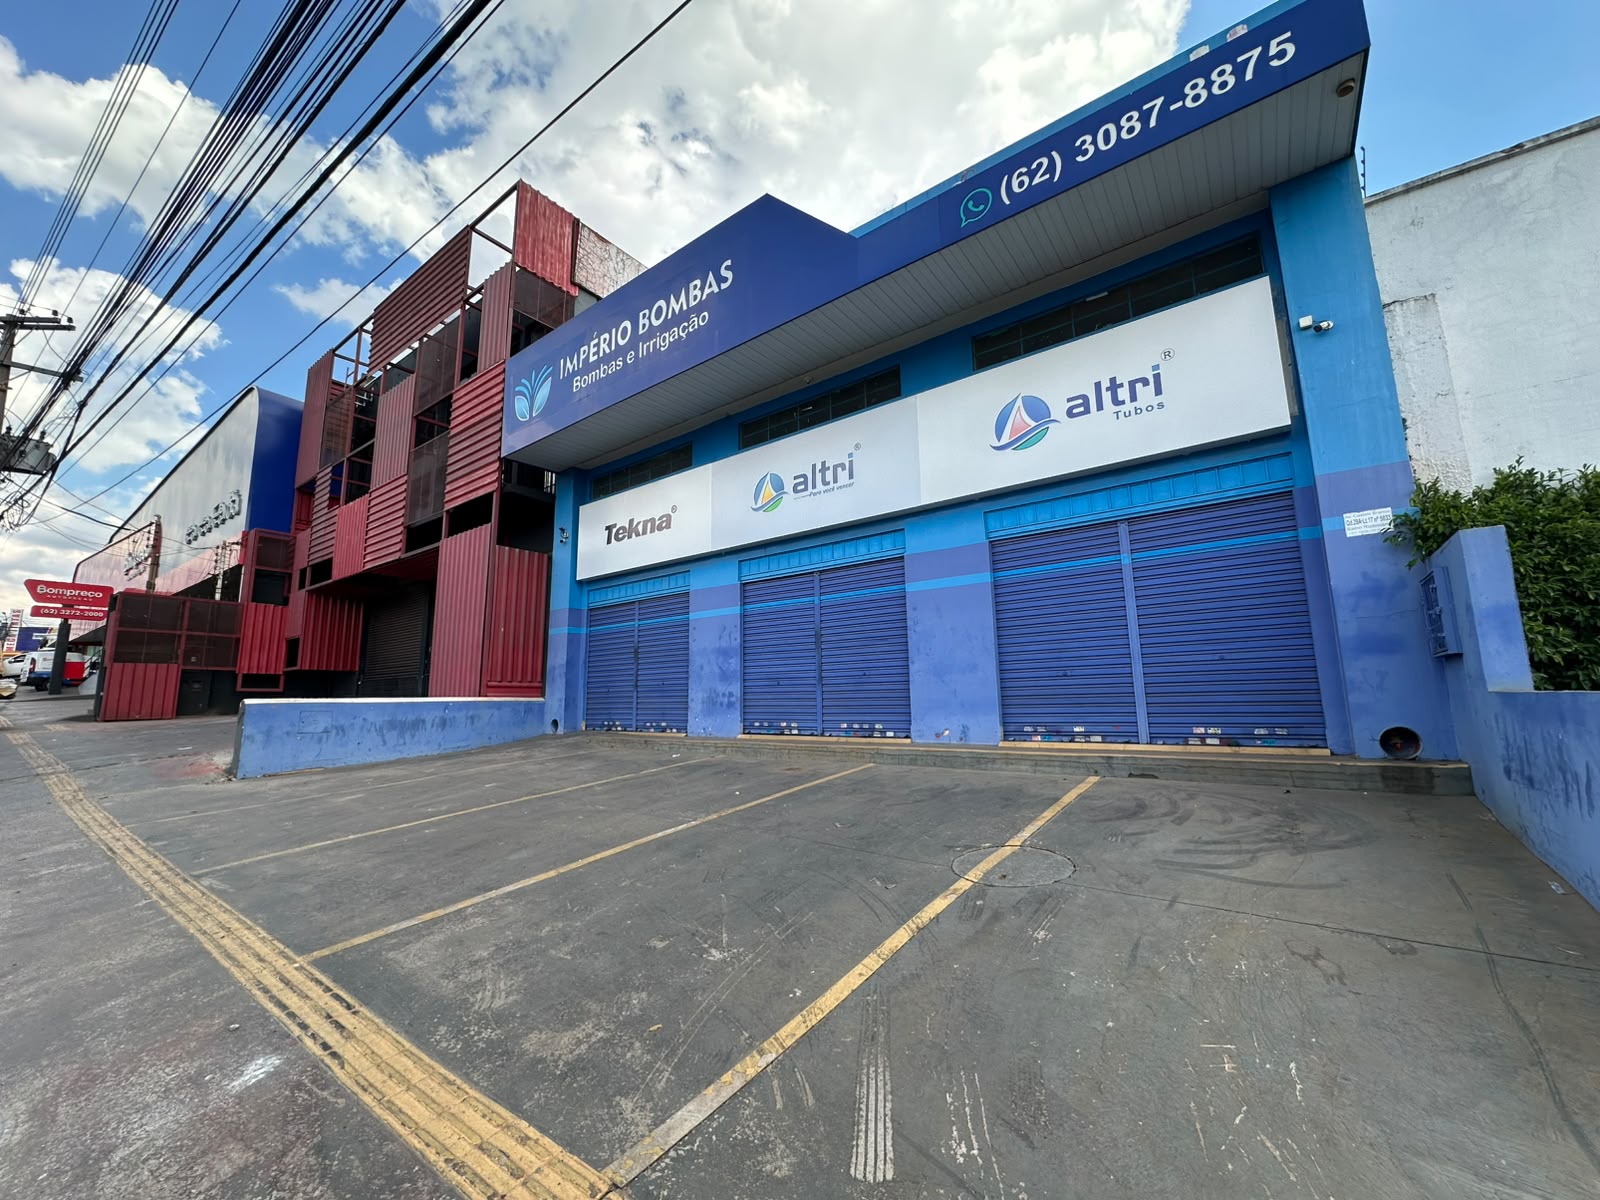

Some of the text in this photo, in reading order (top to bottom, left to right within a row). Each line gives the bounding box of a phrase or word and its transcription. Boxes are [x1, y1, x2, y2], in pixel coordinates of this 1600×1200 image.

[1000, 31, 1297, 205] (62) 3087-8875
[559, 258, 734, 379] IMPÉRIO BOMBAS
[572, 311, 709, 392] Bombas e Irrigação
[1065, 363, 1163, 419] altri
[1113, 401, 1165, 420] Tubos
[792, 452, 854, 494] altri
[605, 511, 673, 545] Tekna
[36, 584, 103, 598] Bompreço
[59, 609, 104, 617] 3272-2000
